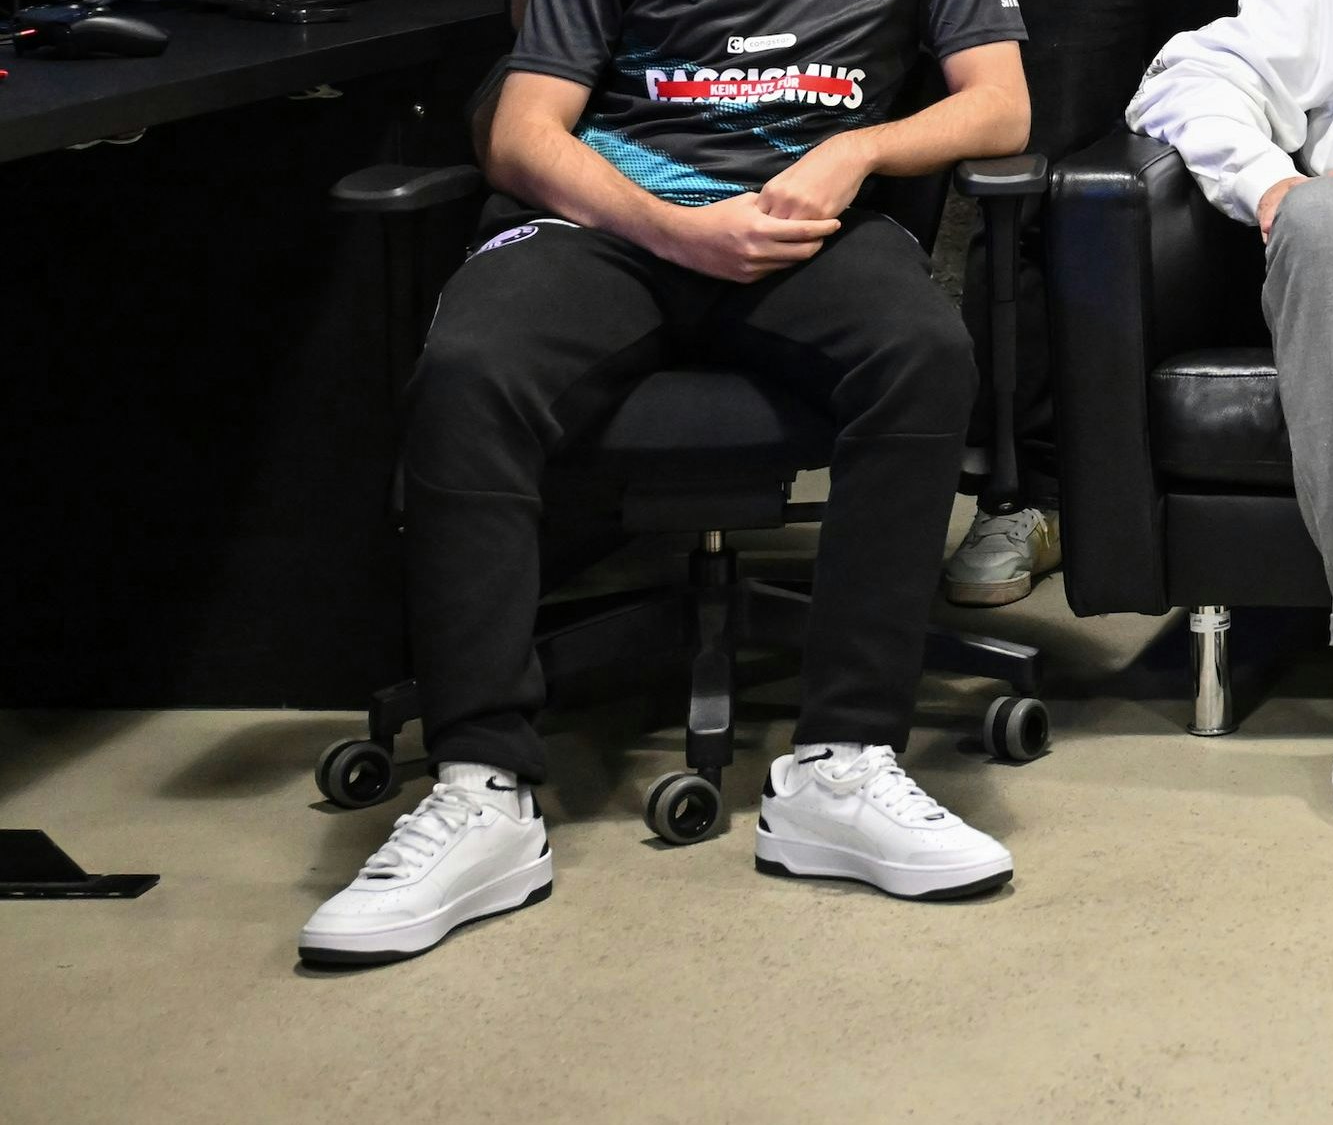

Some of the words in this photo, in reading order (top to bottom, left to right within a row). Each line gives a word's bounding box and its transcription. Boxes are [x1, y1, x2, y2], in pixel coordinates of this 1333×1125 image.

[710, 83, 737, 96] KEIN
[740, 81, 775, 95] PLATZ
[777, 76, 800, 89] FÜR
